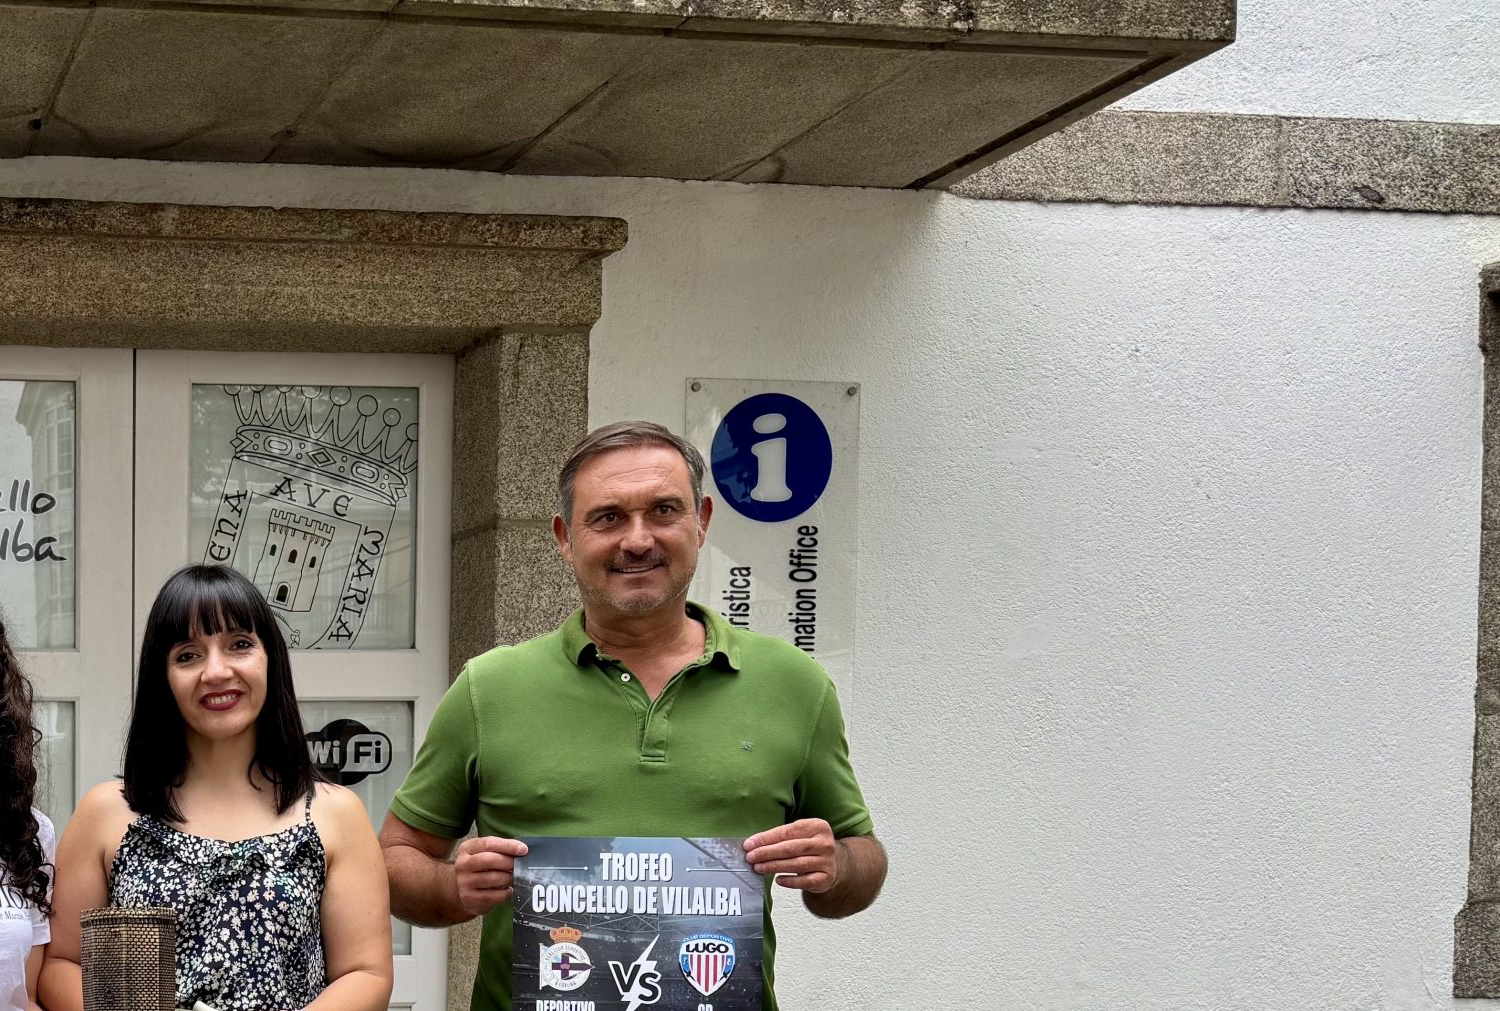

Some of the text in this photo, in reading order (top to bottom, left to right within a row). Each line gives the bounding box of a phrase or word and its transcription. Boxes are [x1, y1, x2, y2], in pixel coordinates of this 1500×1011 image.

[269, 476, 354, 517] AVE
[208, 489, 248, 562] ENA
[327, 525, 385, 642] MARIA
[721, 566, 752, 630] rística
[788, 524, 819, 652] mation Office
[599, 852, 673, 882] TROFEO
[532, 884, 742, 916] CONCELLO DE VILALBA
[686, 942, 730, 954] LUGO
[608, 961, 662, 1003] VS
